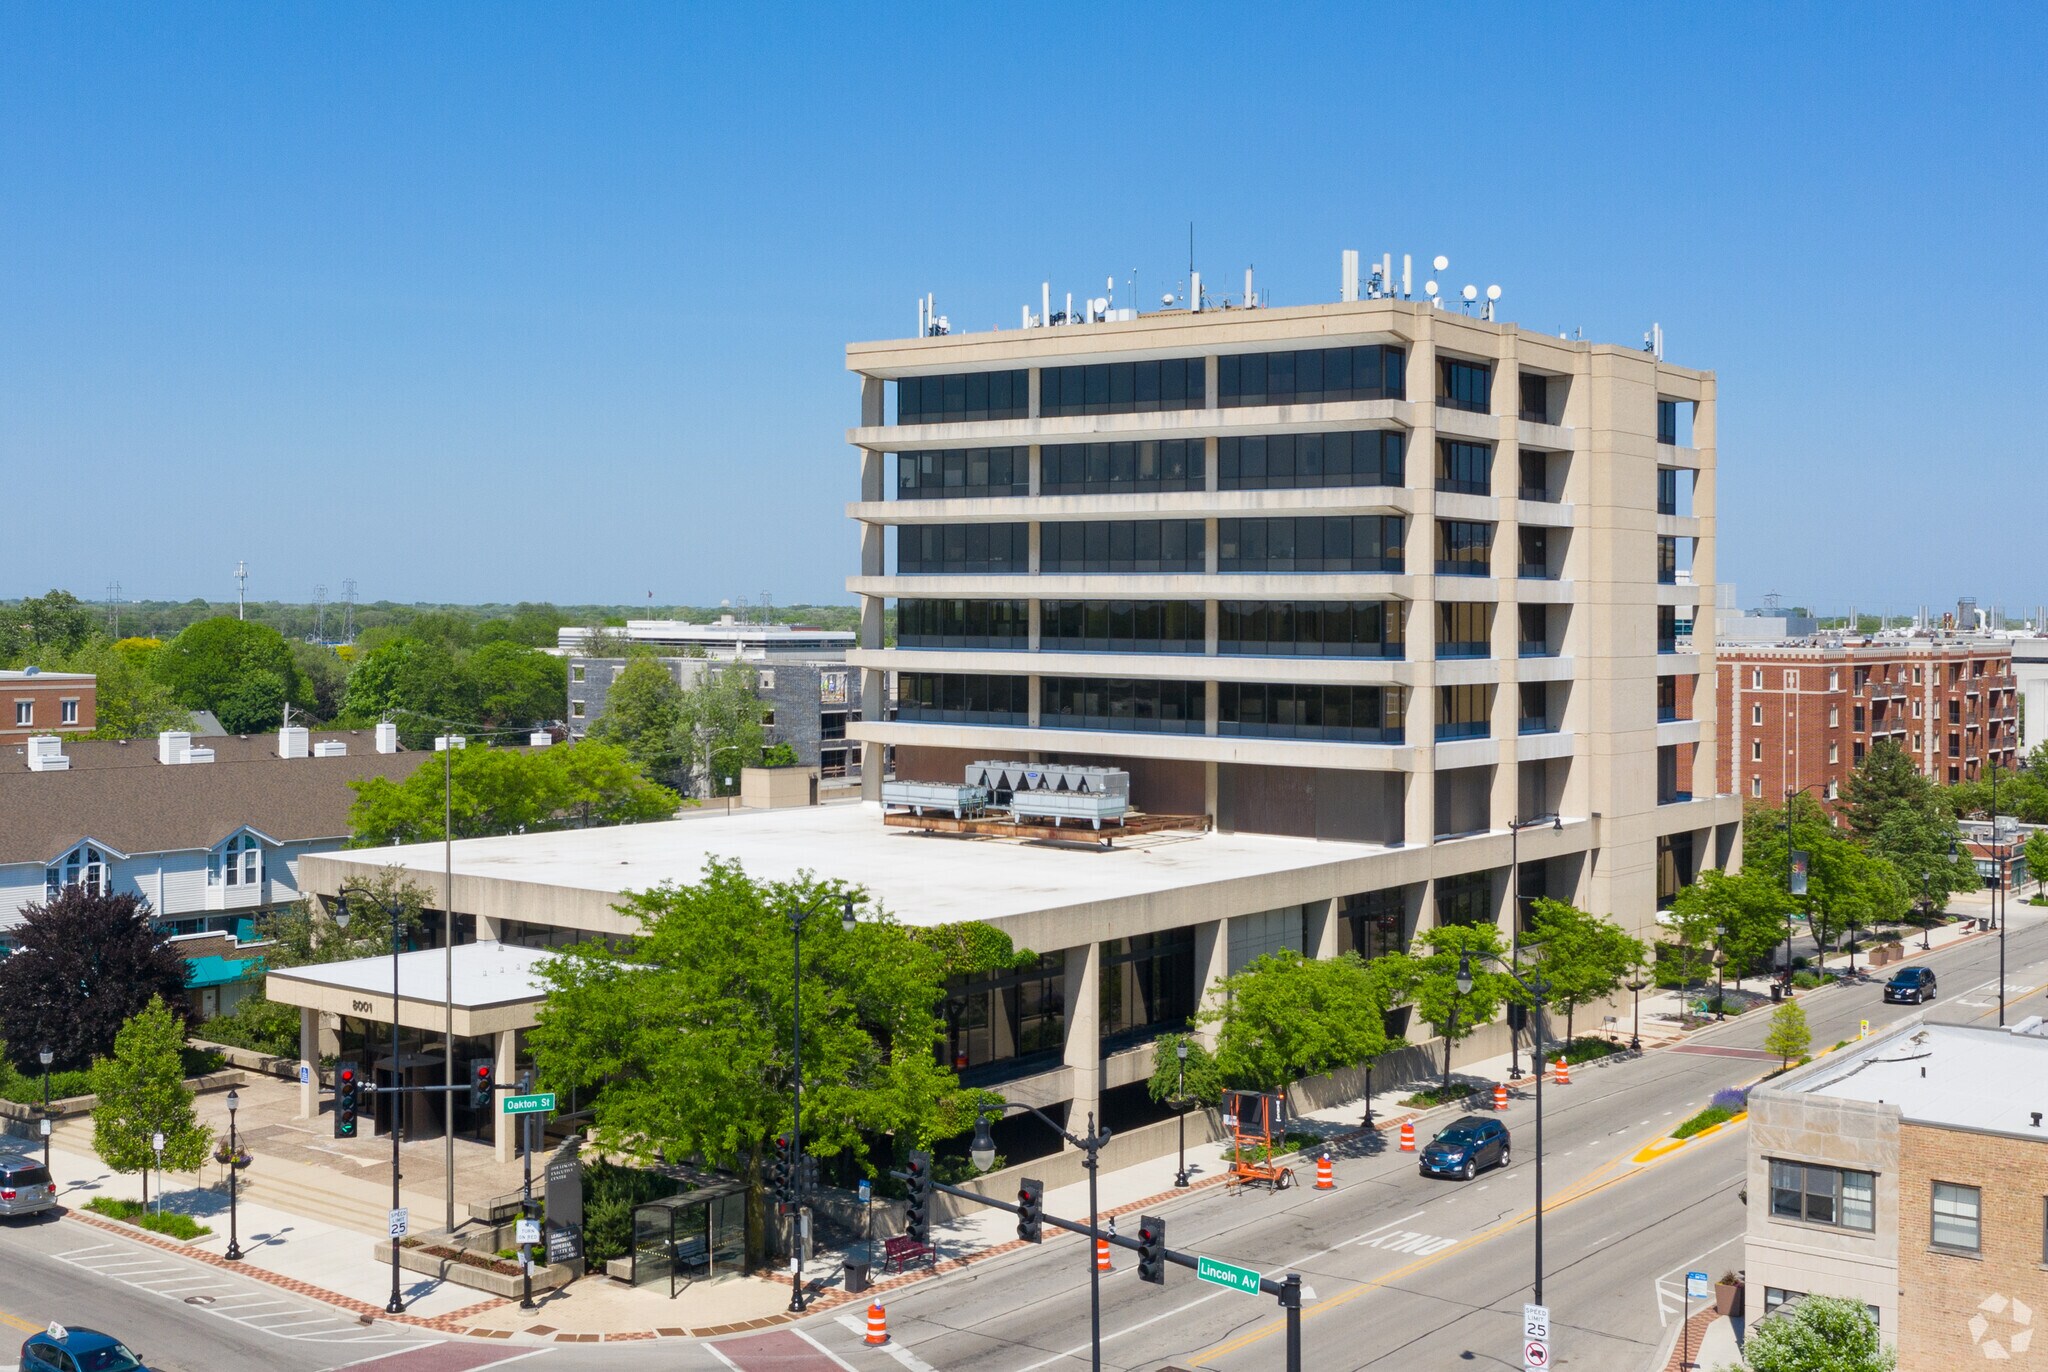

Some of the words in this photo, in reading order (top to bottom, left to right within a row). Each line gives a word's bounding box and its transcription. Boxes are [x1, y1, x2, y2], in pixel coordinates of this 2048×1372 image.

[352, 999, 373, 1014] 8001
[507, 1100, 537, 1110] Oakton
[541, 1097, 550, 1107] St
[390, 1210, 407, 1218] SPEED
[391, 1222, 406, 1234] 25
[1358, 1230, 1459, 1256] ONLY
[1200, 1262, 1237, 1284] Lincoln
[1242, 1274, 1257, 1289] Av
[1526, 1308, 1547, 1316] SPEED
[1527, 1322, 1546, 1337] 25
